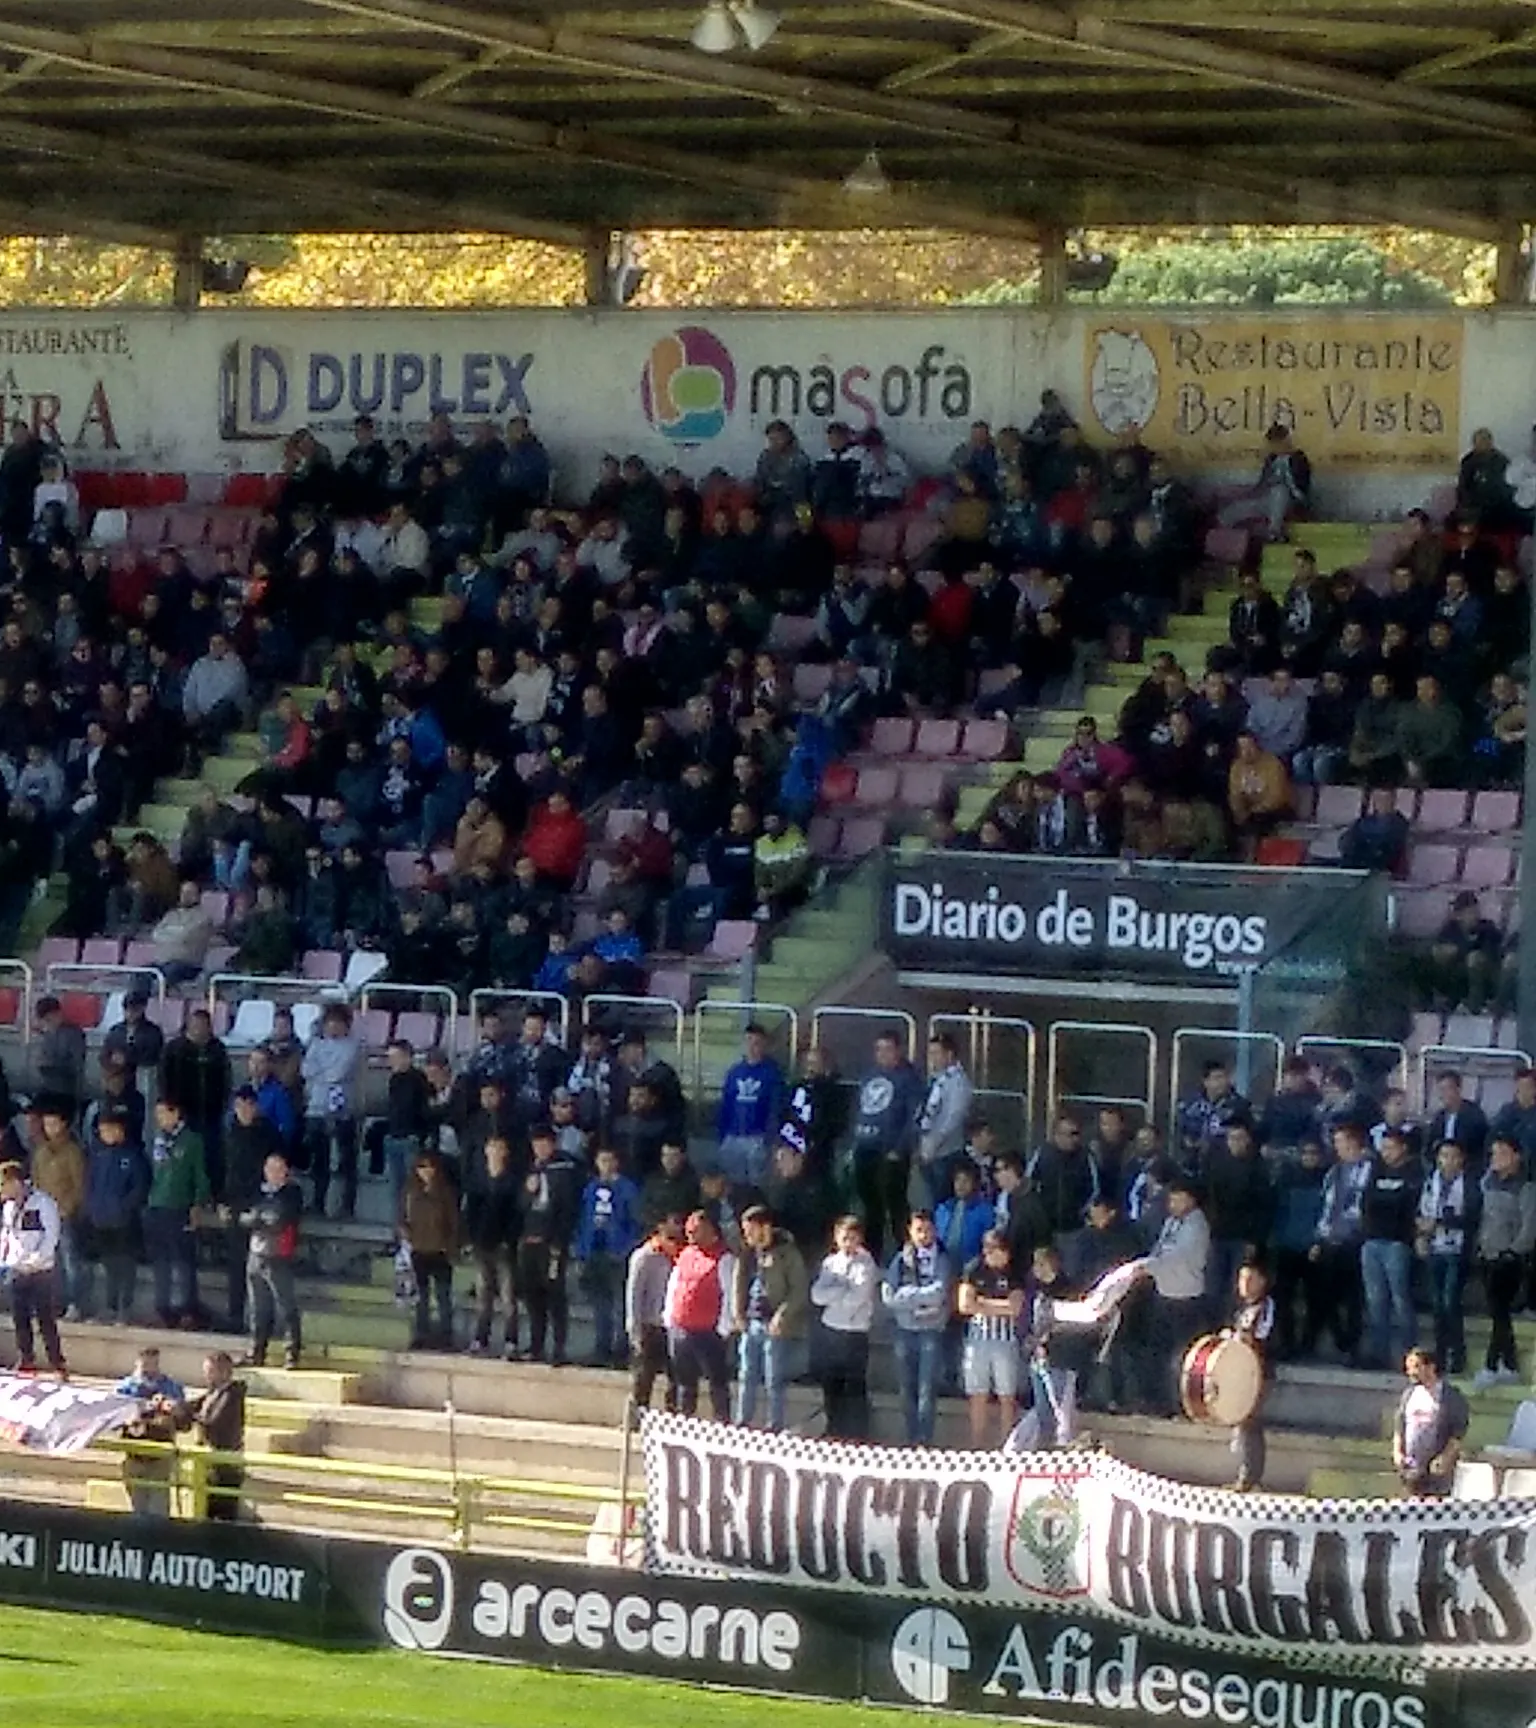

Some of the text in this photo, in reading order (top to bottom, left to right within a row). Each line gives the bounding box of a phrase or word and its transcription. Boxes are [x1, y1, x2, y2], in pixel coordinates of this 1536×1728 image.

[307, 352, 534, 414] DUPLEX
[1169, 329, 1454, 375] Restaurante
[894, 883, 1267, 969] Diario de Burgos
[661, 1441, 994, 1593] REDUCTO
[55, 1540, 144, 1581] JULIÁN
[148, 1551, 306, 1603] AUTO-SPORT
[1104, 1492, 1533, 1645] BURGALES
[473, 1580, 801, 1671] arcecarne
